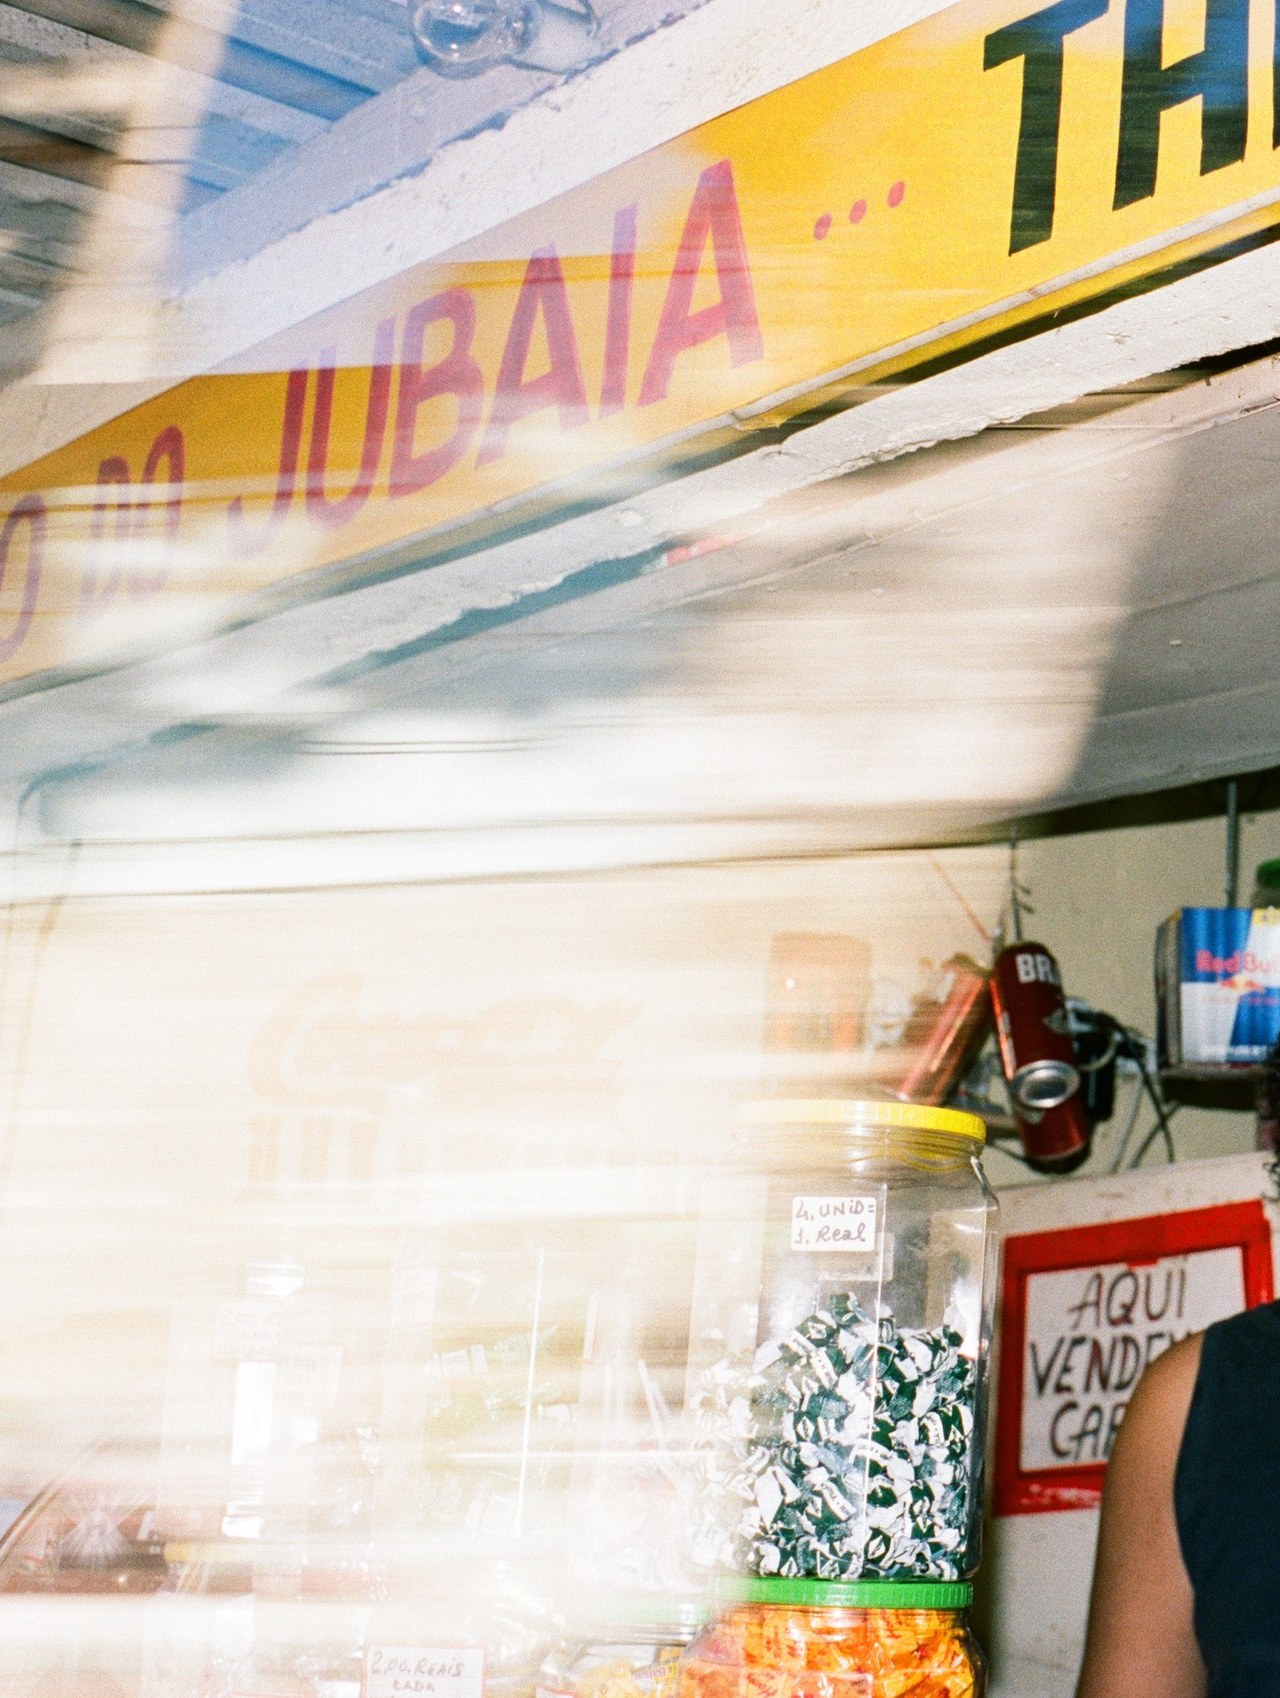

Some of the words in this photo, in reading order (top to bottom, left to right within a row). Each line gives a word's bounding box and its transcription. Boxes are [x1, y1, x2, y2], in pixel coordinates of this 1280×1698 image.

[227, 158, 765, 558] JUBAIA
[1015, 953, 1060, 985] BR
[1028, 1332, 1191, 1398] VEND
